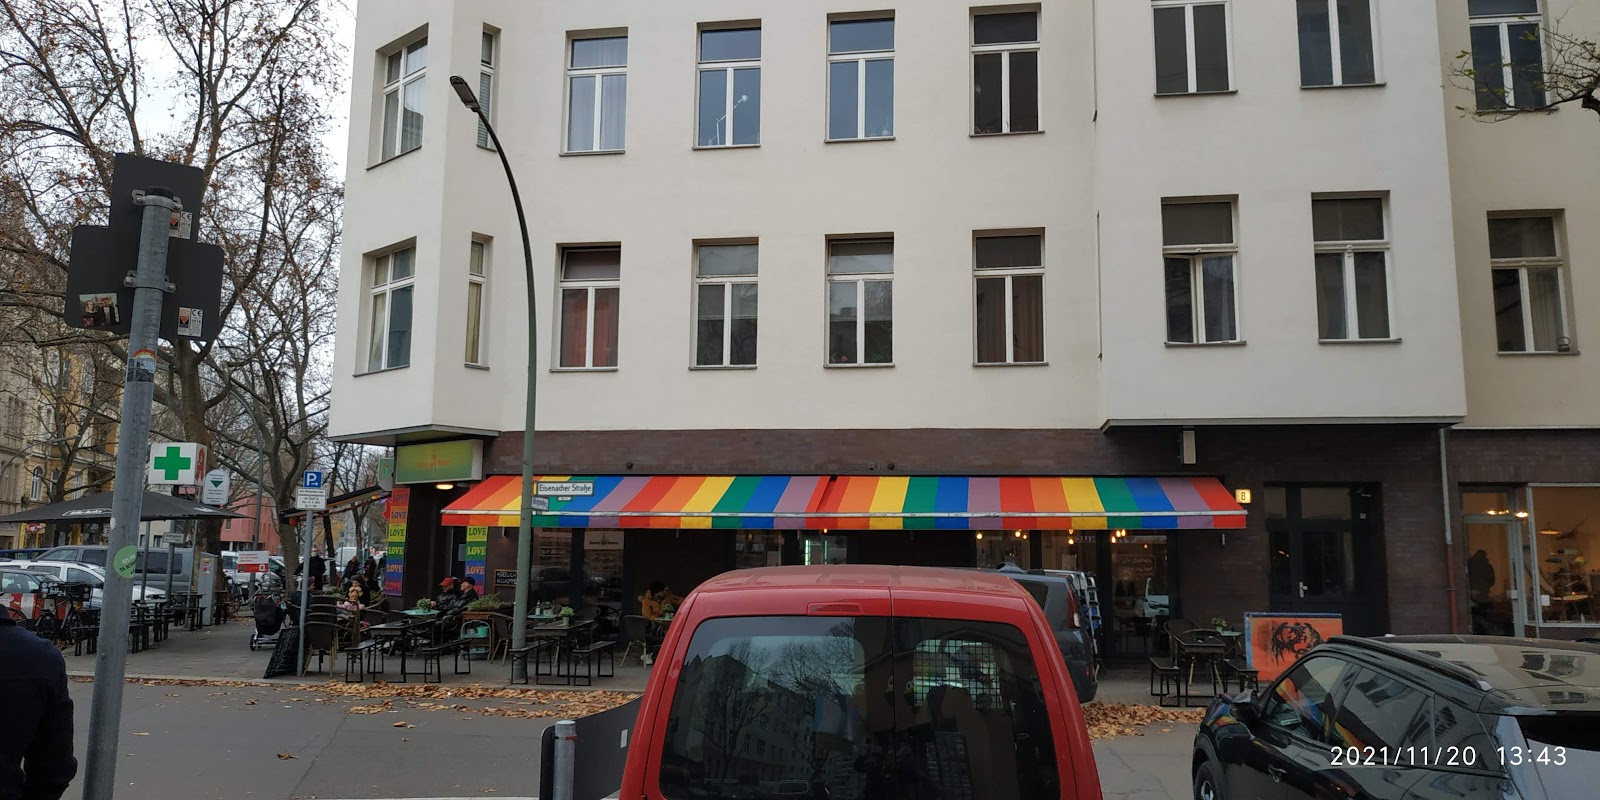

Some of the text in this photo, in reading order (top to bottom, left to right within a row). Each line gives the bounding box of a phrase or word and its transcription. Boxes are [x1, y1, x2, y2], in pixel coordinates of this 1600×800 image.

[306, 473, 317, 486] P
[539, 484, 592, 493] Eisenacher Straße
[392, 493, 408, 502] LOVE
[1241, 492, 1246, 500] 8
[391, 511, 407, 519] LOVE
[389, 529, 405, 537] LOVE
[468, 527, 487, 536] LOVE
[388, 546, 404, 555] LOVE
[467, 546, 486, 556] LOVE
[386, 564, 403, 573] LOVE
[465, 565, 485, 575] LOVE
[384, 581, 401, 590] LOVE
